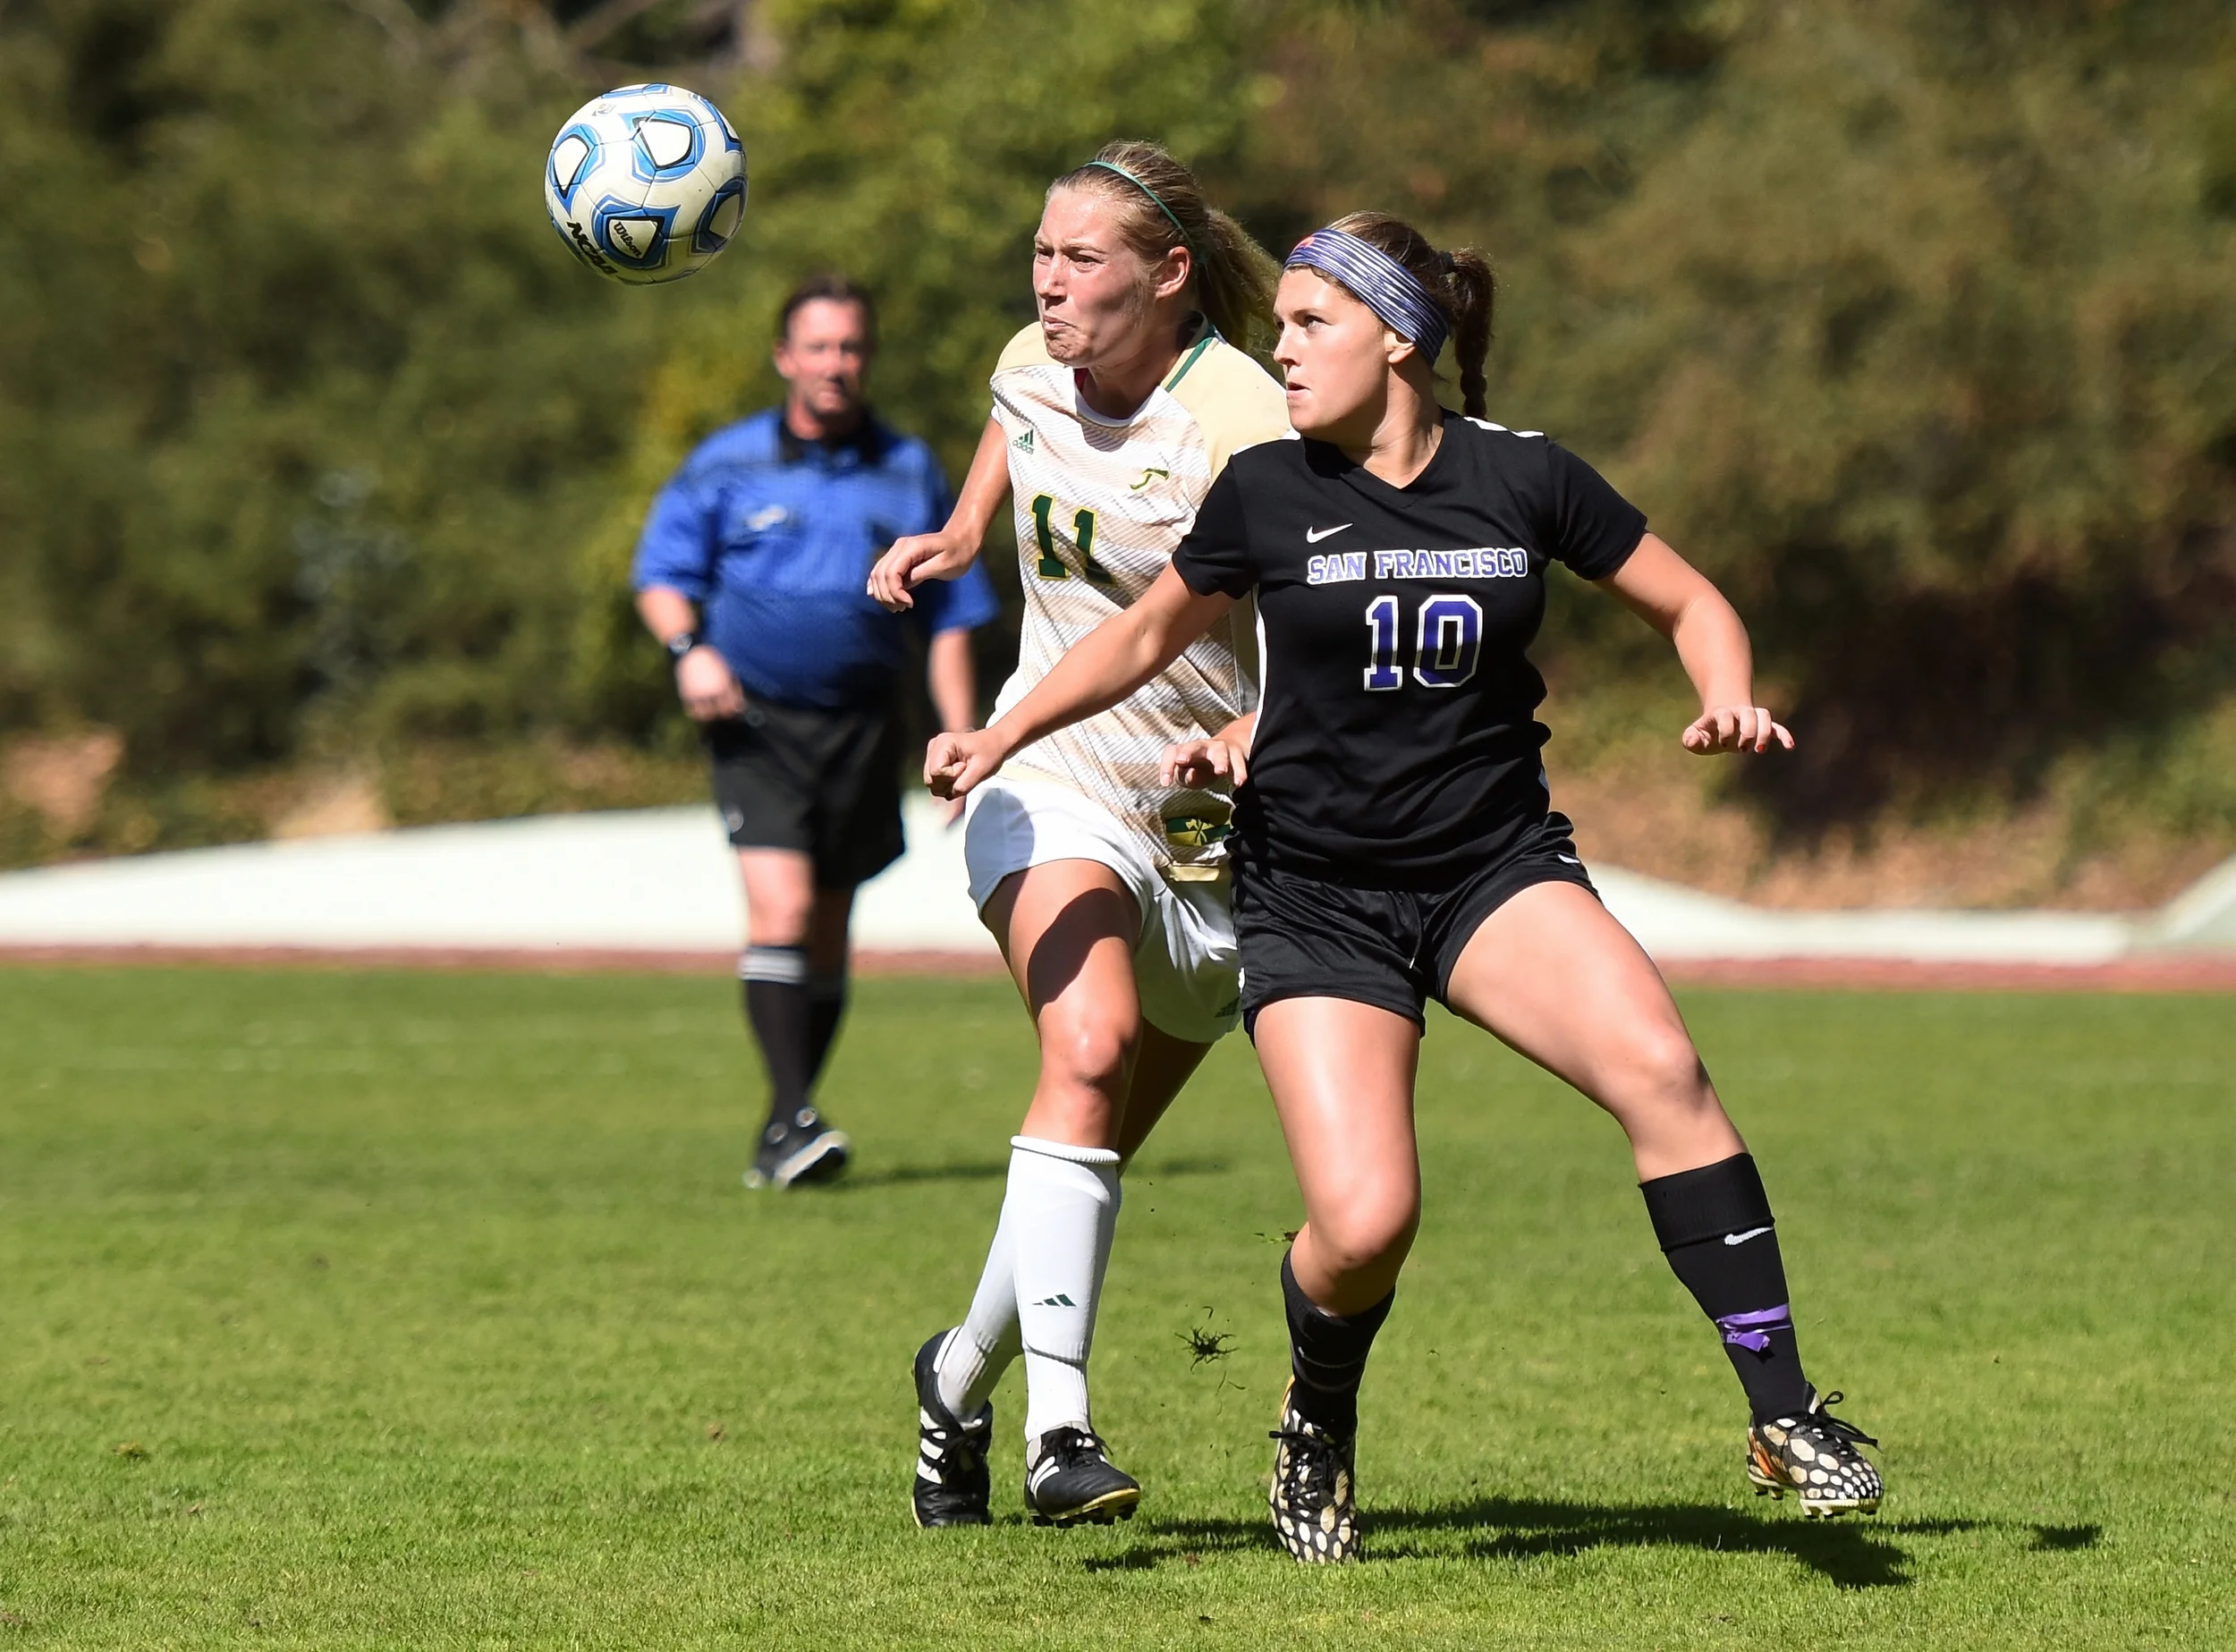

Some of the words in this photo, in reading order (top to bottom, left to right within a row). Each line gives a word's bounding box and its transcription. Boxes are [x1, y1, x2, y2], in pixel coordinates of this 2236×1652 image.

[566, 222, 618, 275] NCAA
[614, 221, 642, 257] Wilson
[1030, 492, 1118, 586] 11
[1307, 551, 1367, 585] SAN
[1373, 547, 1528, 579] FRANCISCO
[1364, 594, 1483, 691] 10
